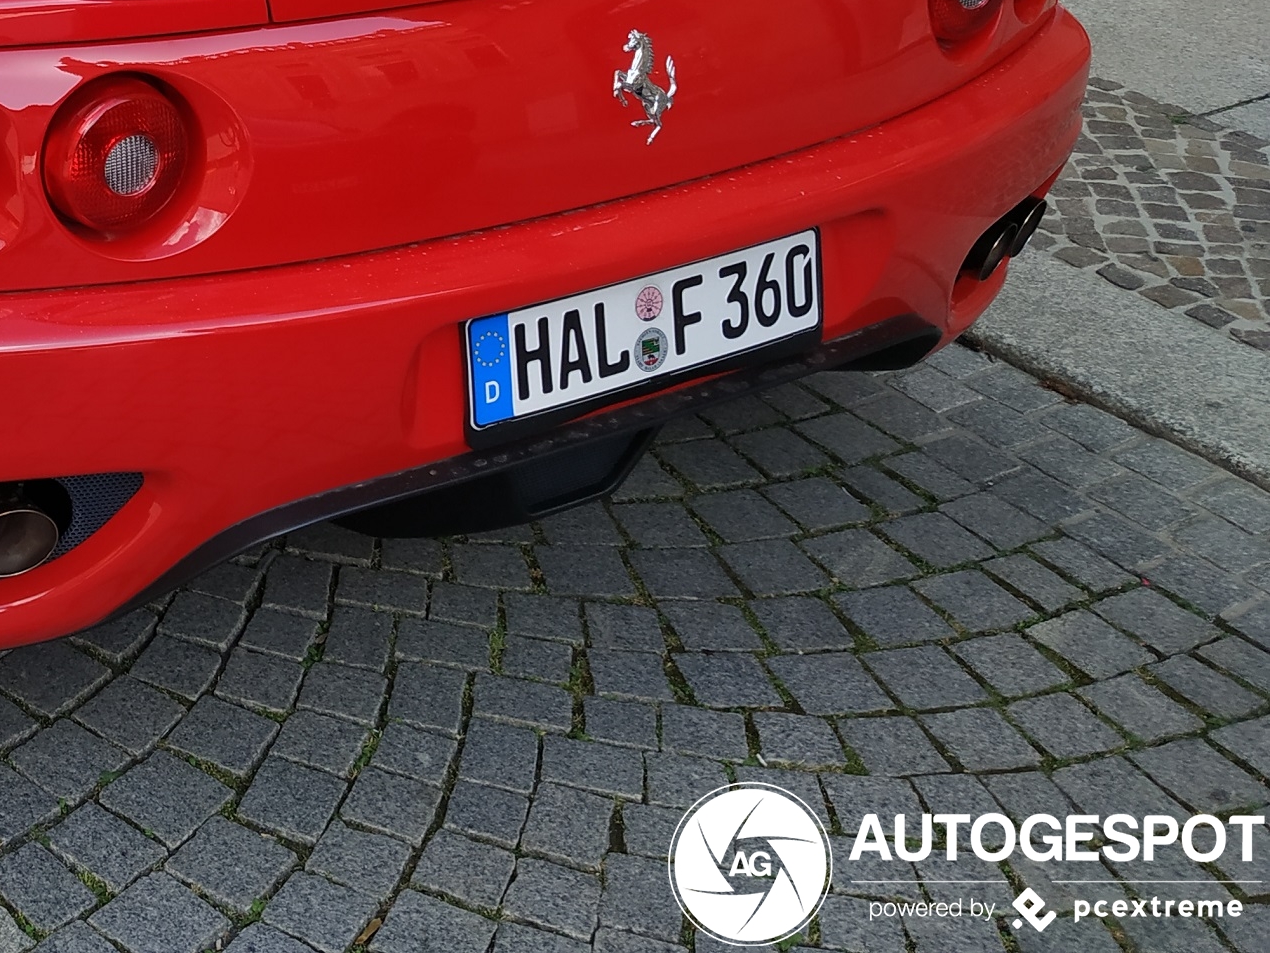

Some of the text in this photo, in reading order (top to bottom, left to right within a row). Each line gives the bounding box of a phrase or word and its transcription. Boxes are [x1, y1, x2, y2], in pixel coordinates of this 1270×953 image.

[513, 302, 630, 401] HAL
[671, 274, 703, 356] F
[719, 244, 814, 340] 360
[485, 380, 500, 404] D
